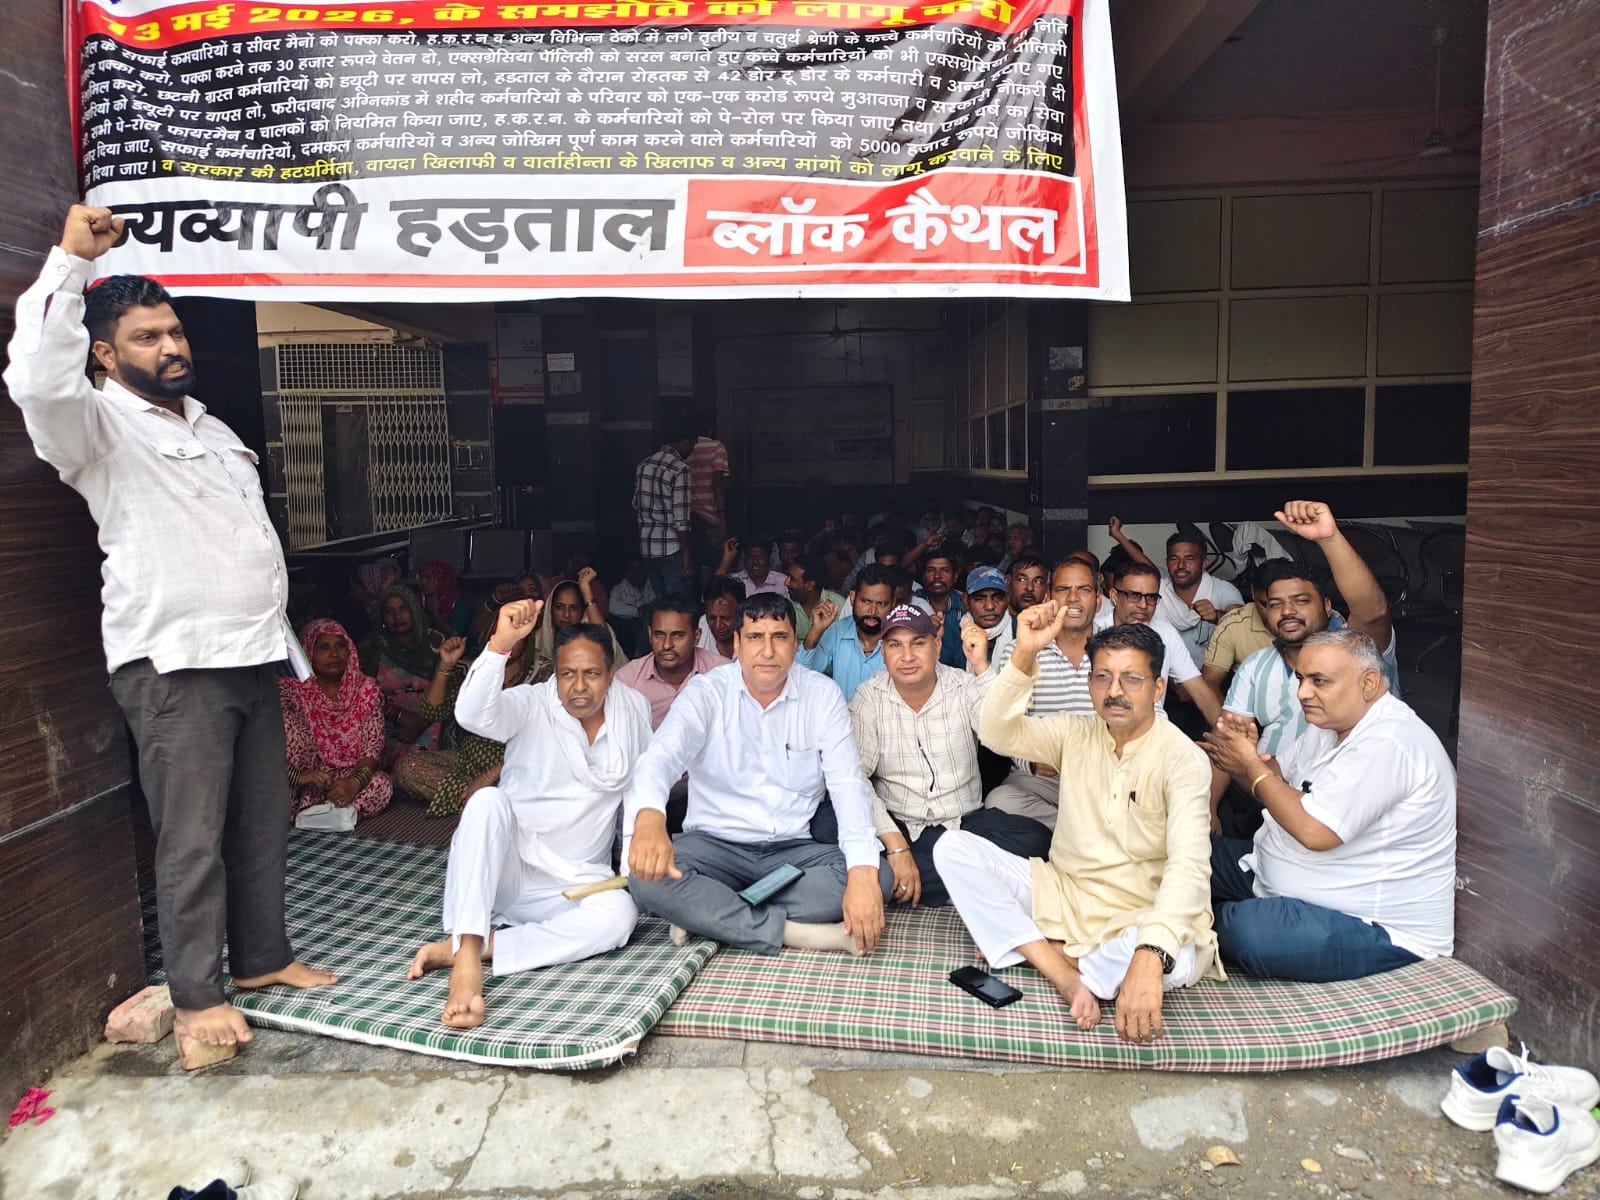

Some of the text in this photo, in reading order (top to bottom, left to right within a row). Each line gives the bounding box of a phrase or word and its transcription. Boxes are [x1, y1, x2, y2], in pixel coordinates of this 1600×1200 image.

[171, 3, 235, 30] मई
[249, 8, 414, 24] 2026,
[433, 3, 485, 21] के
[792, 1, 917, 25] लागू
[276, 59, 294, 71] 30
[718, 70, 741, 82] 42
[860, 139, 901, 155] 5000
[389, 198, 676, 264] हड़ताल
[706, 196, 869, 256] ब्लॉक
[885, 187, 1058, 254] कैथल
